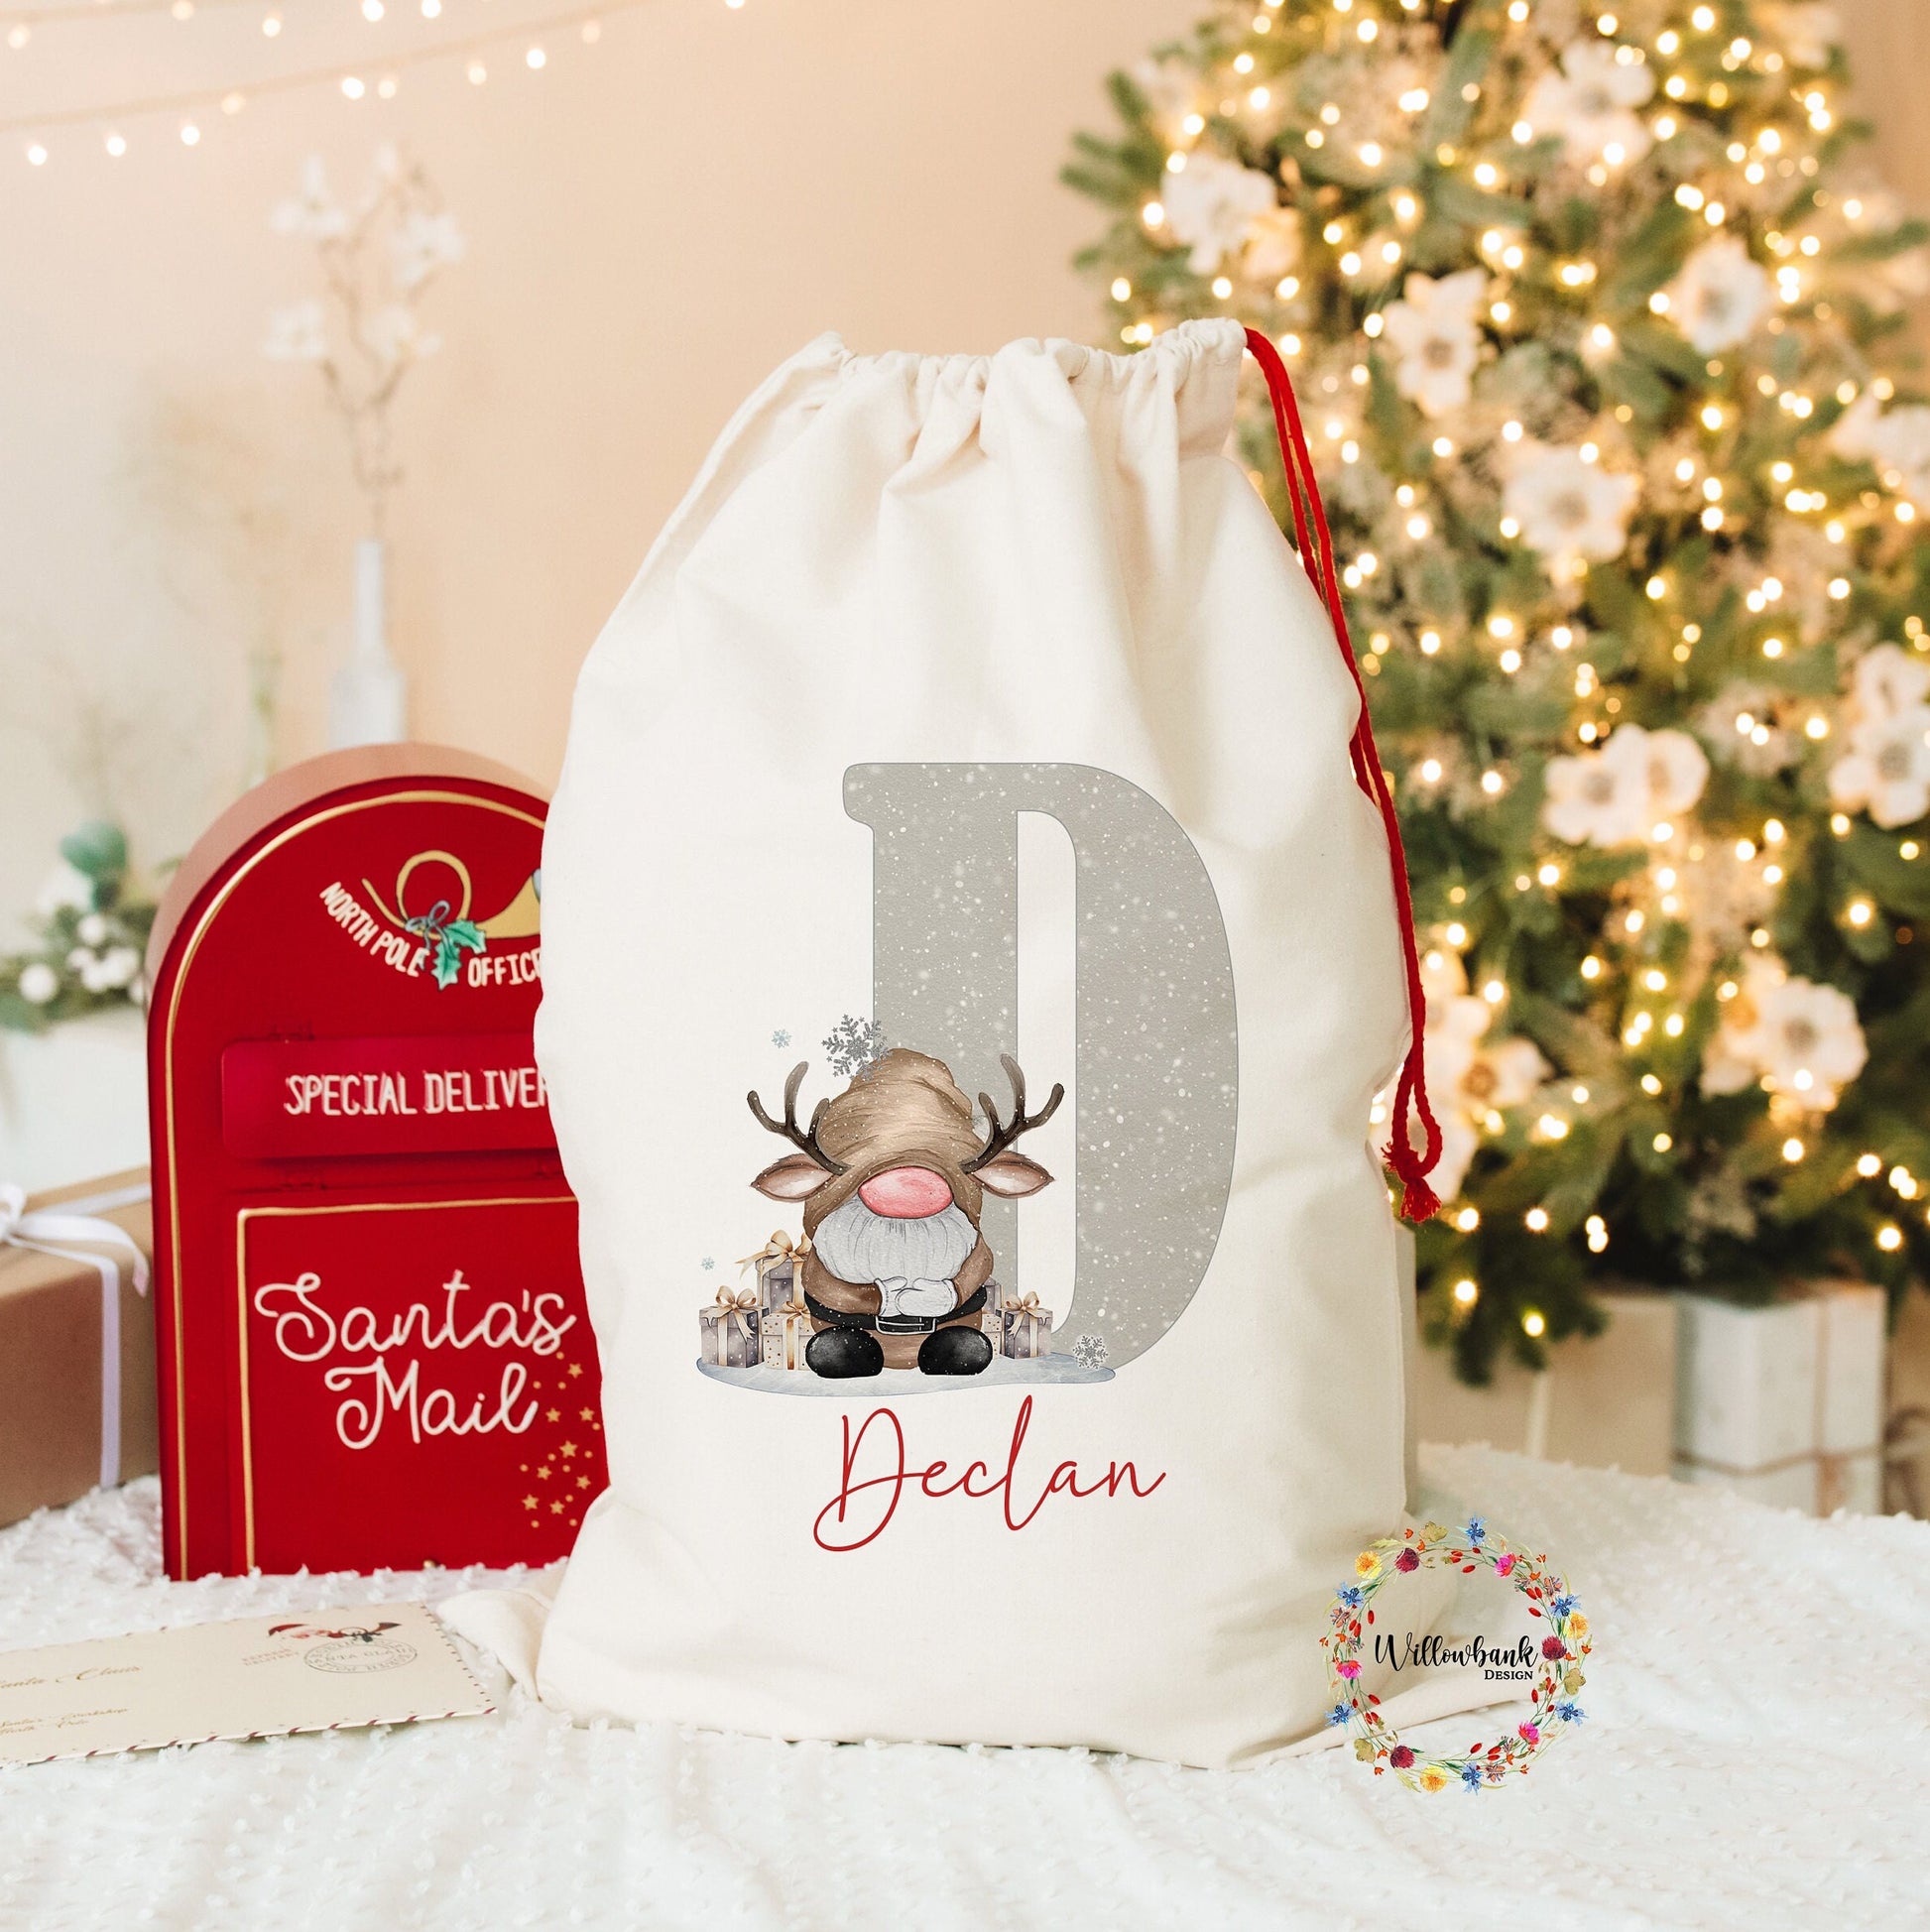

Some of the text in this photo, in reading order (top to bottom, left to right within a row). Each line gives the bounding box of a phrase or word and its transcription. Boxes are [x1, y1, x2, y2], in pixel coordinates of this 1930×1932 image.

[319, 881, 379, 947] NORTH
[370, 929, 430, 978] POLE
[284, 1071, 418, 1116] SPECIAL
[842, 763, 1239, 1370] D
[254, 1268, 577, 1362] Santa's
[324, 1356, 539, 1450] Mail
[813, 1394, 1166, 1552] Declan
